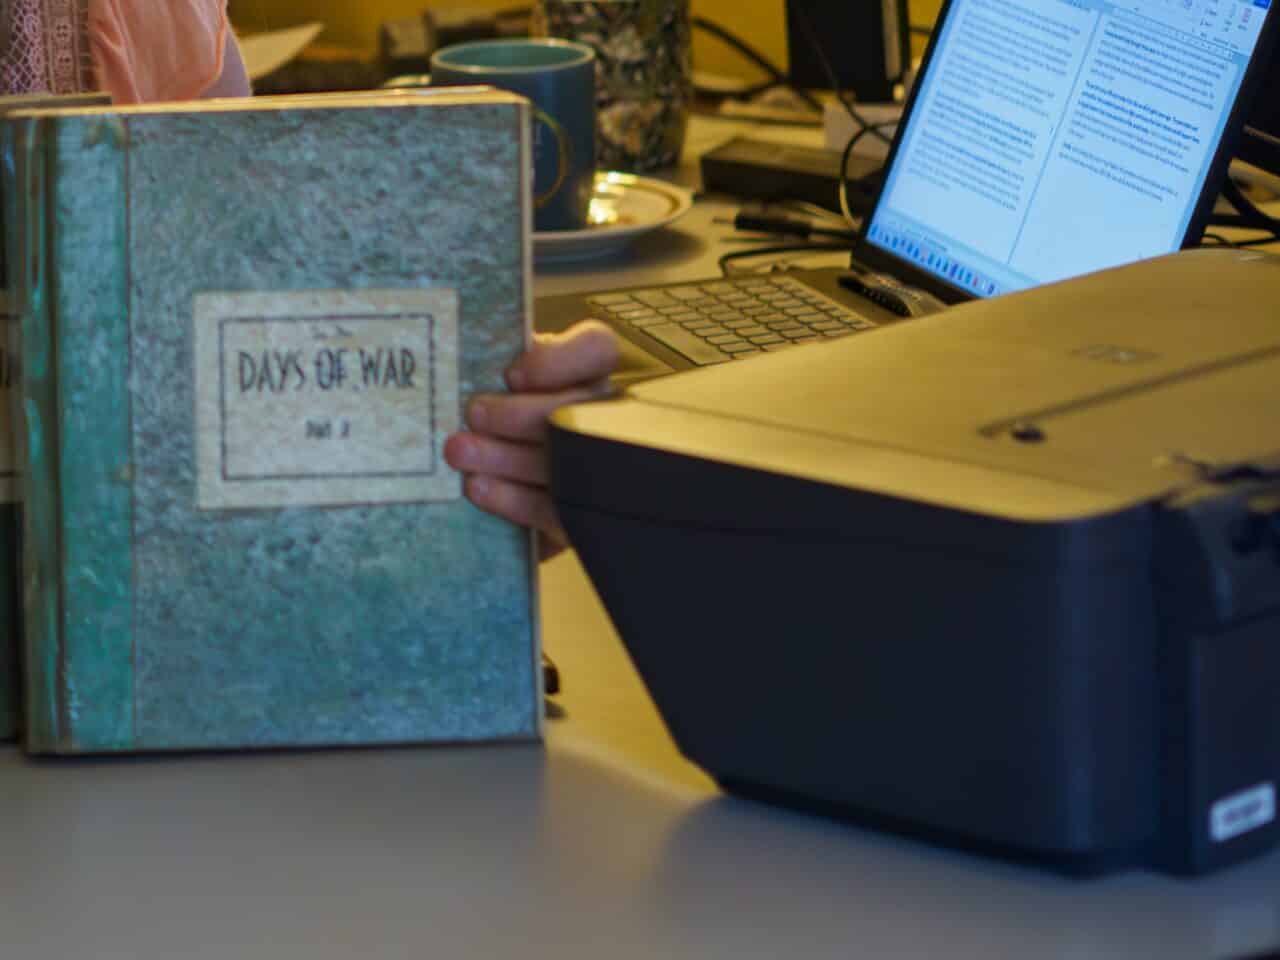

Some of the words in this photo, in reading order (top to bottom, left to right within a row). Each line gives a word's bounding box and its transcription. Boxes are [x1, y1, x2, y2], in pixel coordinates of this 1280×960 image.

[238, 348, 306, 392] DAYS
[314, 348, 349, 391] OF
[357, 347, 417, 388] WAR
